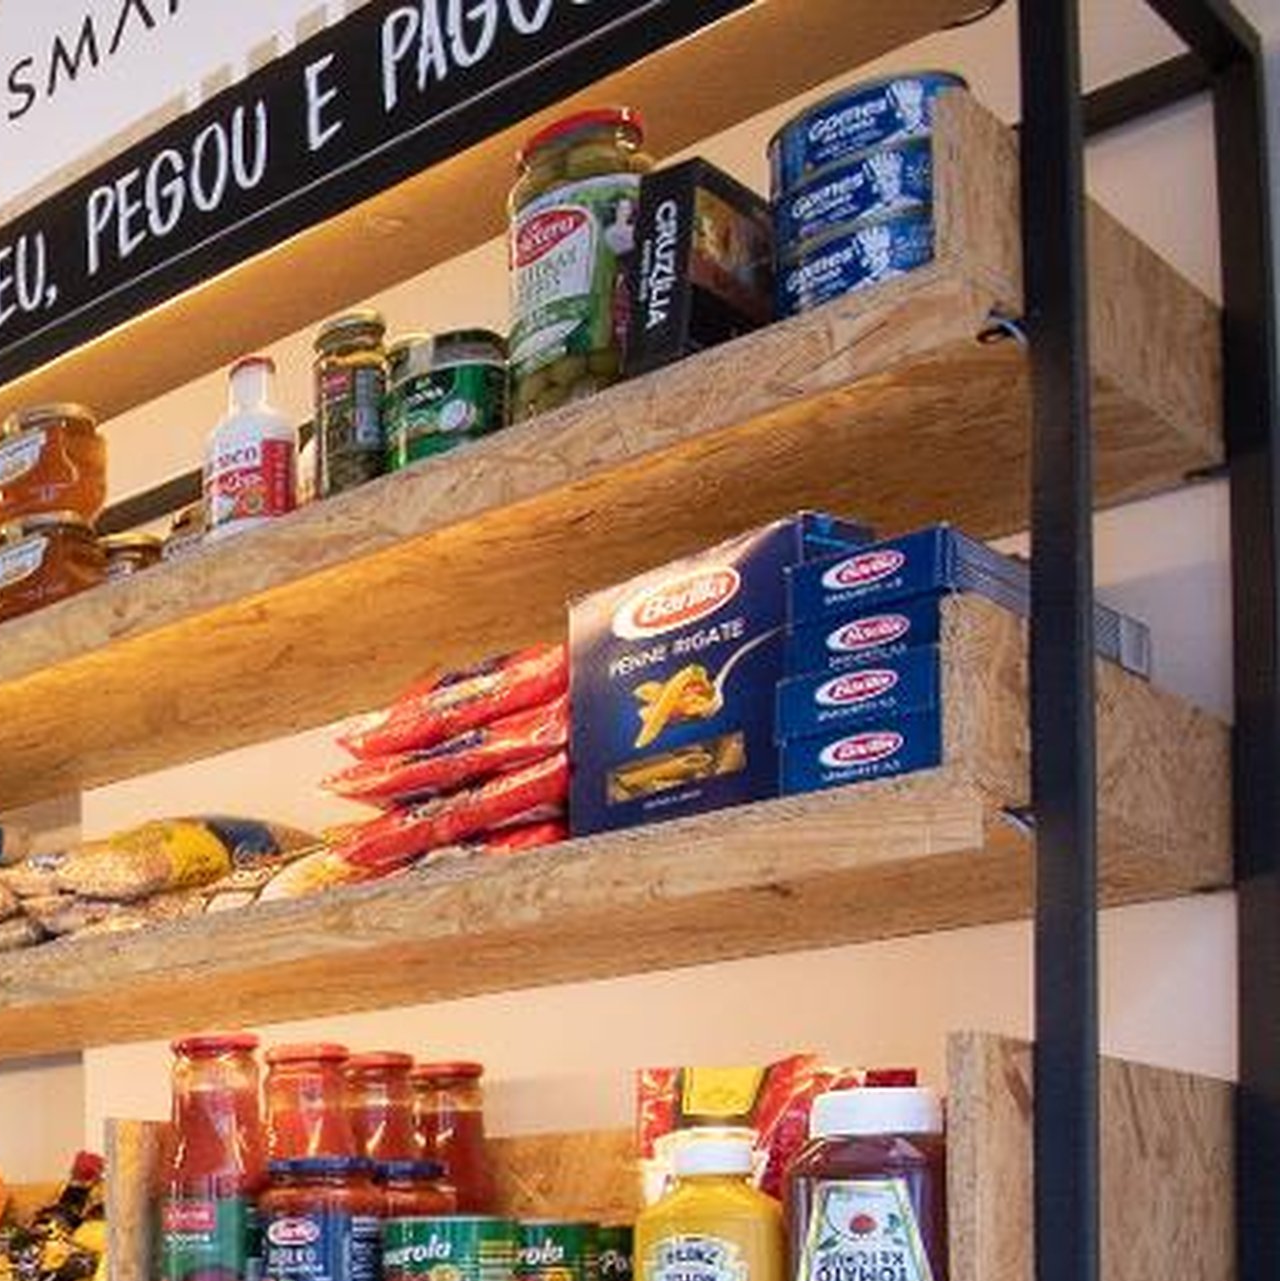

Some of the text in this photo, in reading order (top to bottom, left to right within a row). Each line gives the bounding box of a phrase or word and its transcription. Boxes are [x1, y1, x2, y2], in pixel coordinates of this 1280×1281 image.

[6, 0, 180, 120] SMA
[86, 101, 267, 275] PEGOU
[304, 52, 342, 152] E
